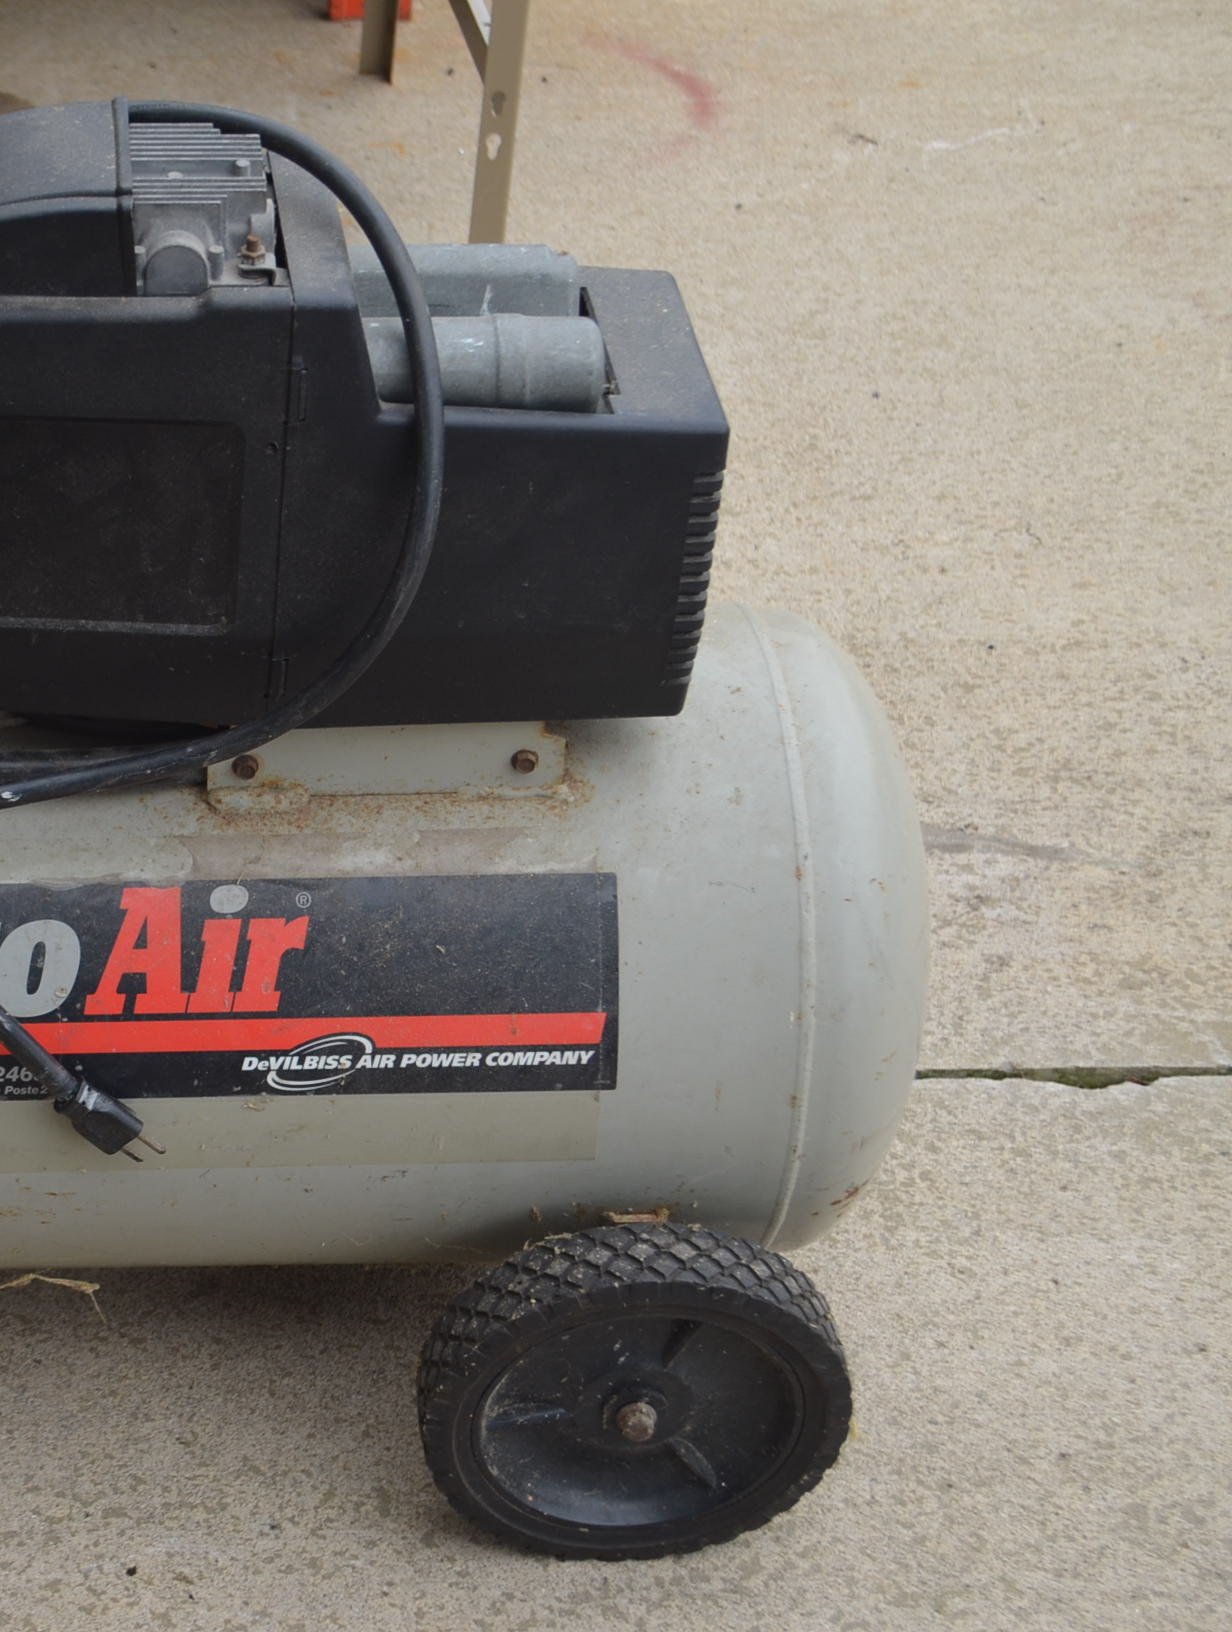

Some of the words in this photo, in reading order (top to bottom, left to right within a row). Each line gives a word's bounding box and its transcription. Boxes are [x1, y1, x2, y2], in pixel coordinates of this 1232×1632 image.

[84, 884, 309, 1015] Air
[241, 1053, 352, 1071] DeVILBISS
[355, 1053, 394, 1070] AIR
[400, 1052, 480, 1068] POWER
[485, 1050, 595, 1067] COMPANY
[4, 1085, 39, 1095] Poste
